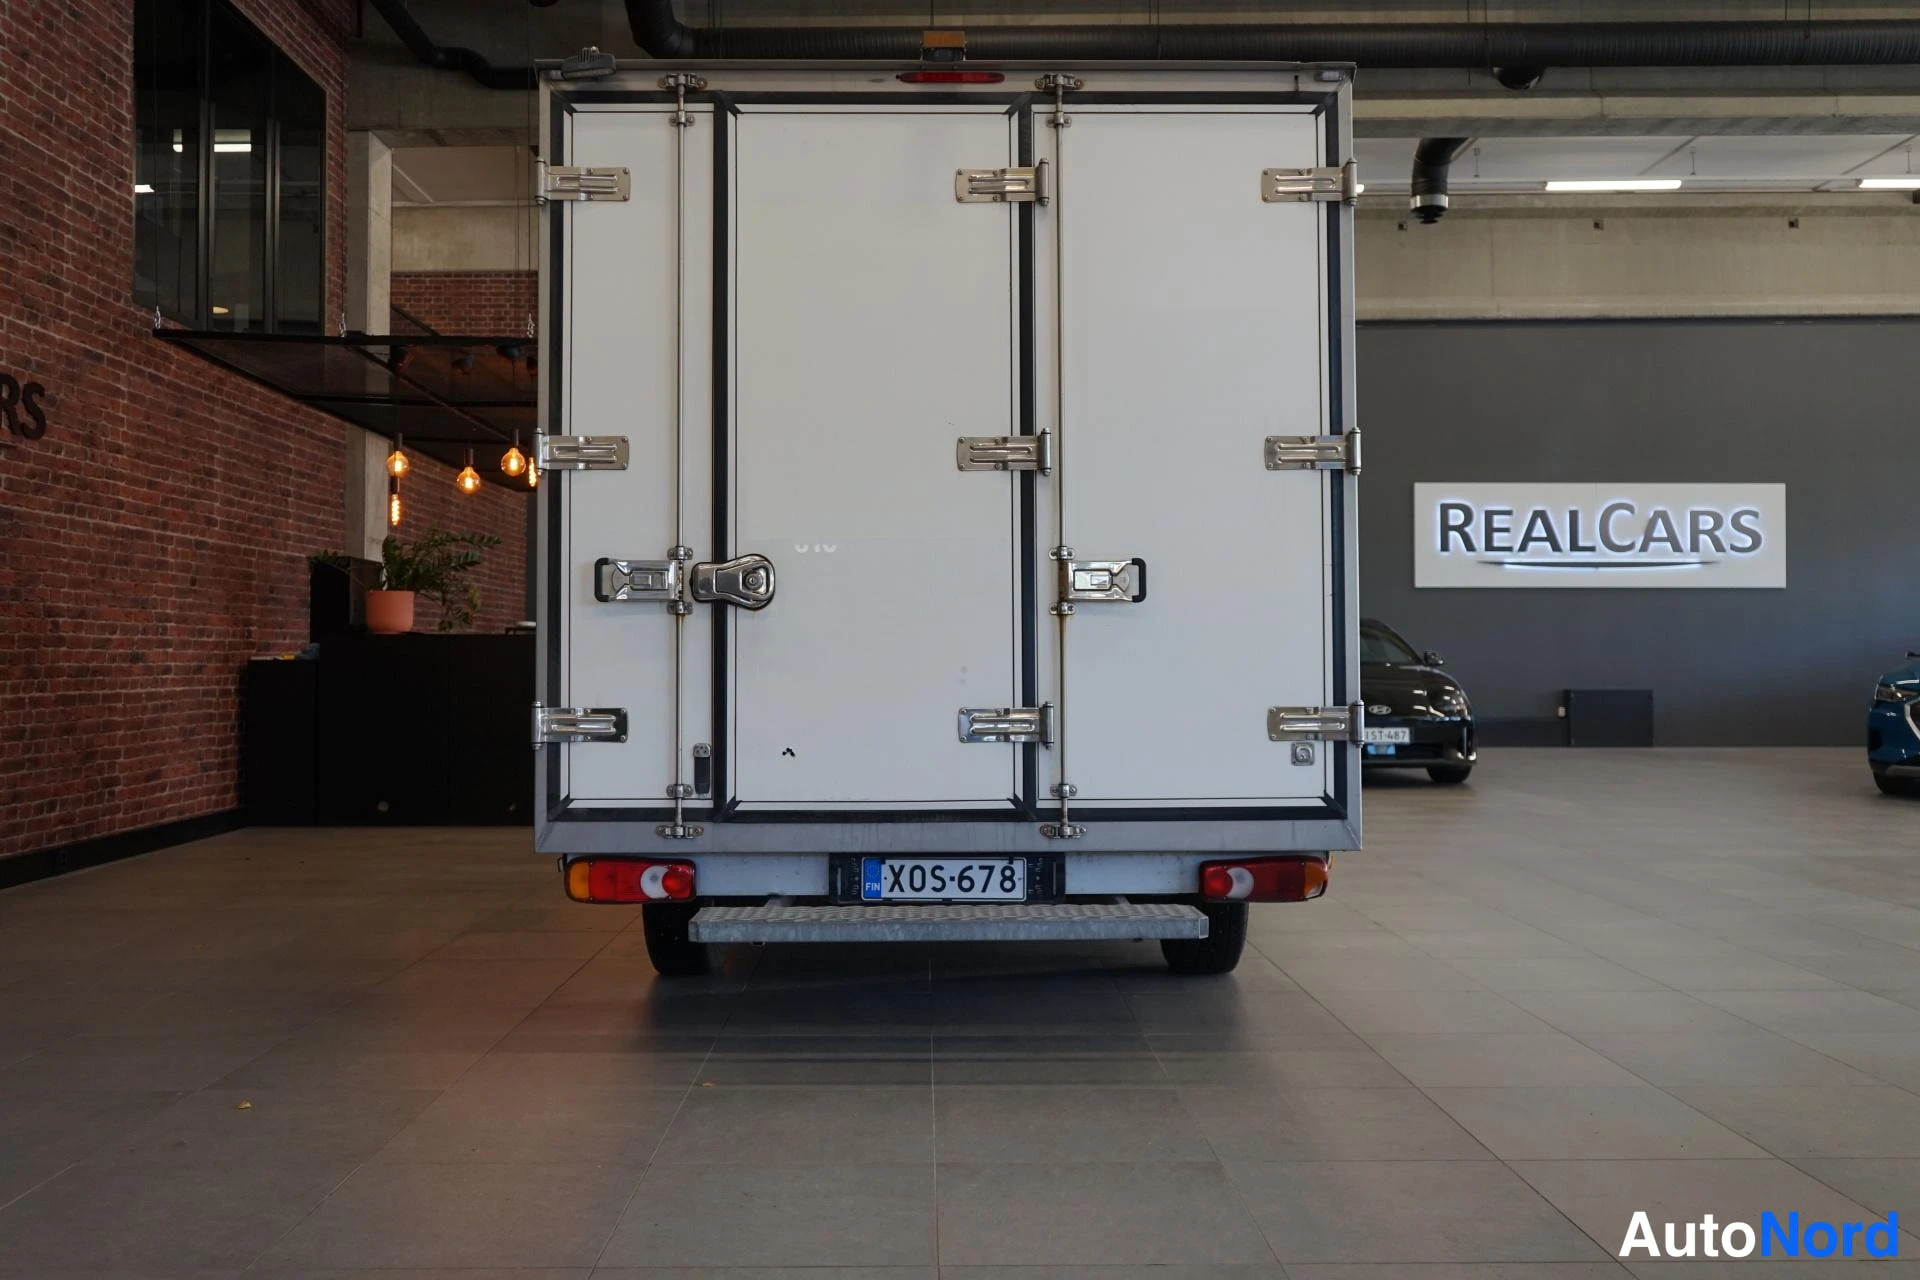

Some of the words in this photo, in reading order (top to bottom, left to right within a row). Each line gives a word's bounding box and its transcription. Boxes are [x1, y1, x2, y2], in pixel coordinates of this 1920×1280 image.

[1439, 501, 1764, 554] REALCARS
[865, 882, 881, 892] FIN
[888, 864, 1016, 894] XOS-678
